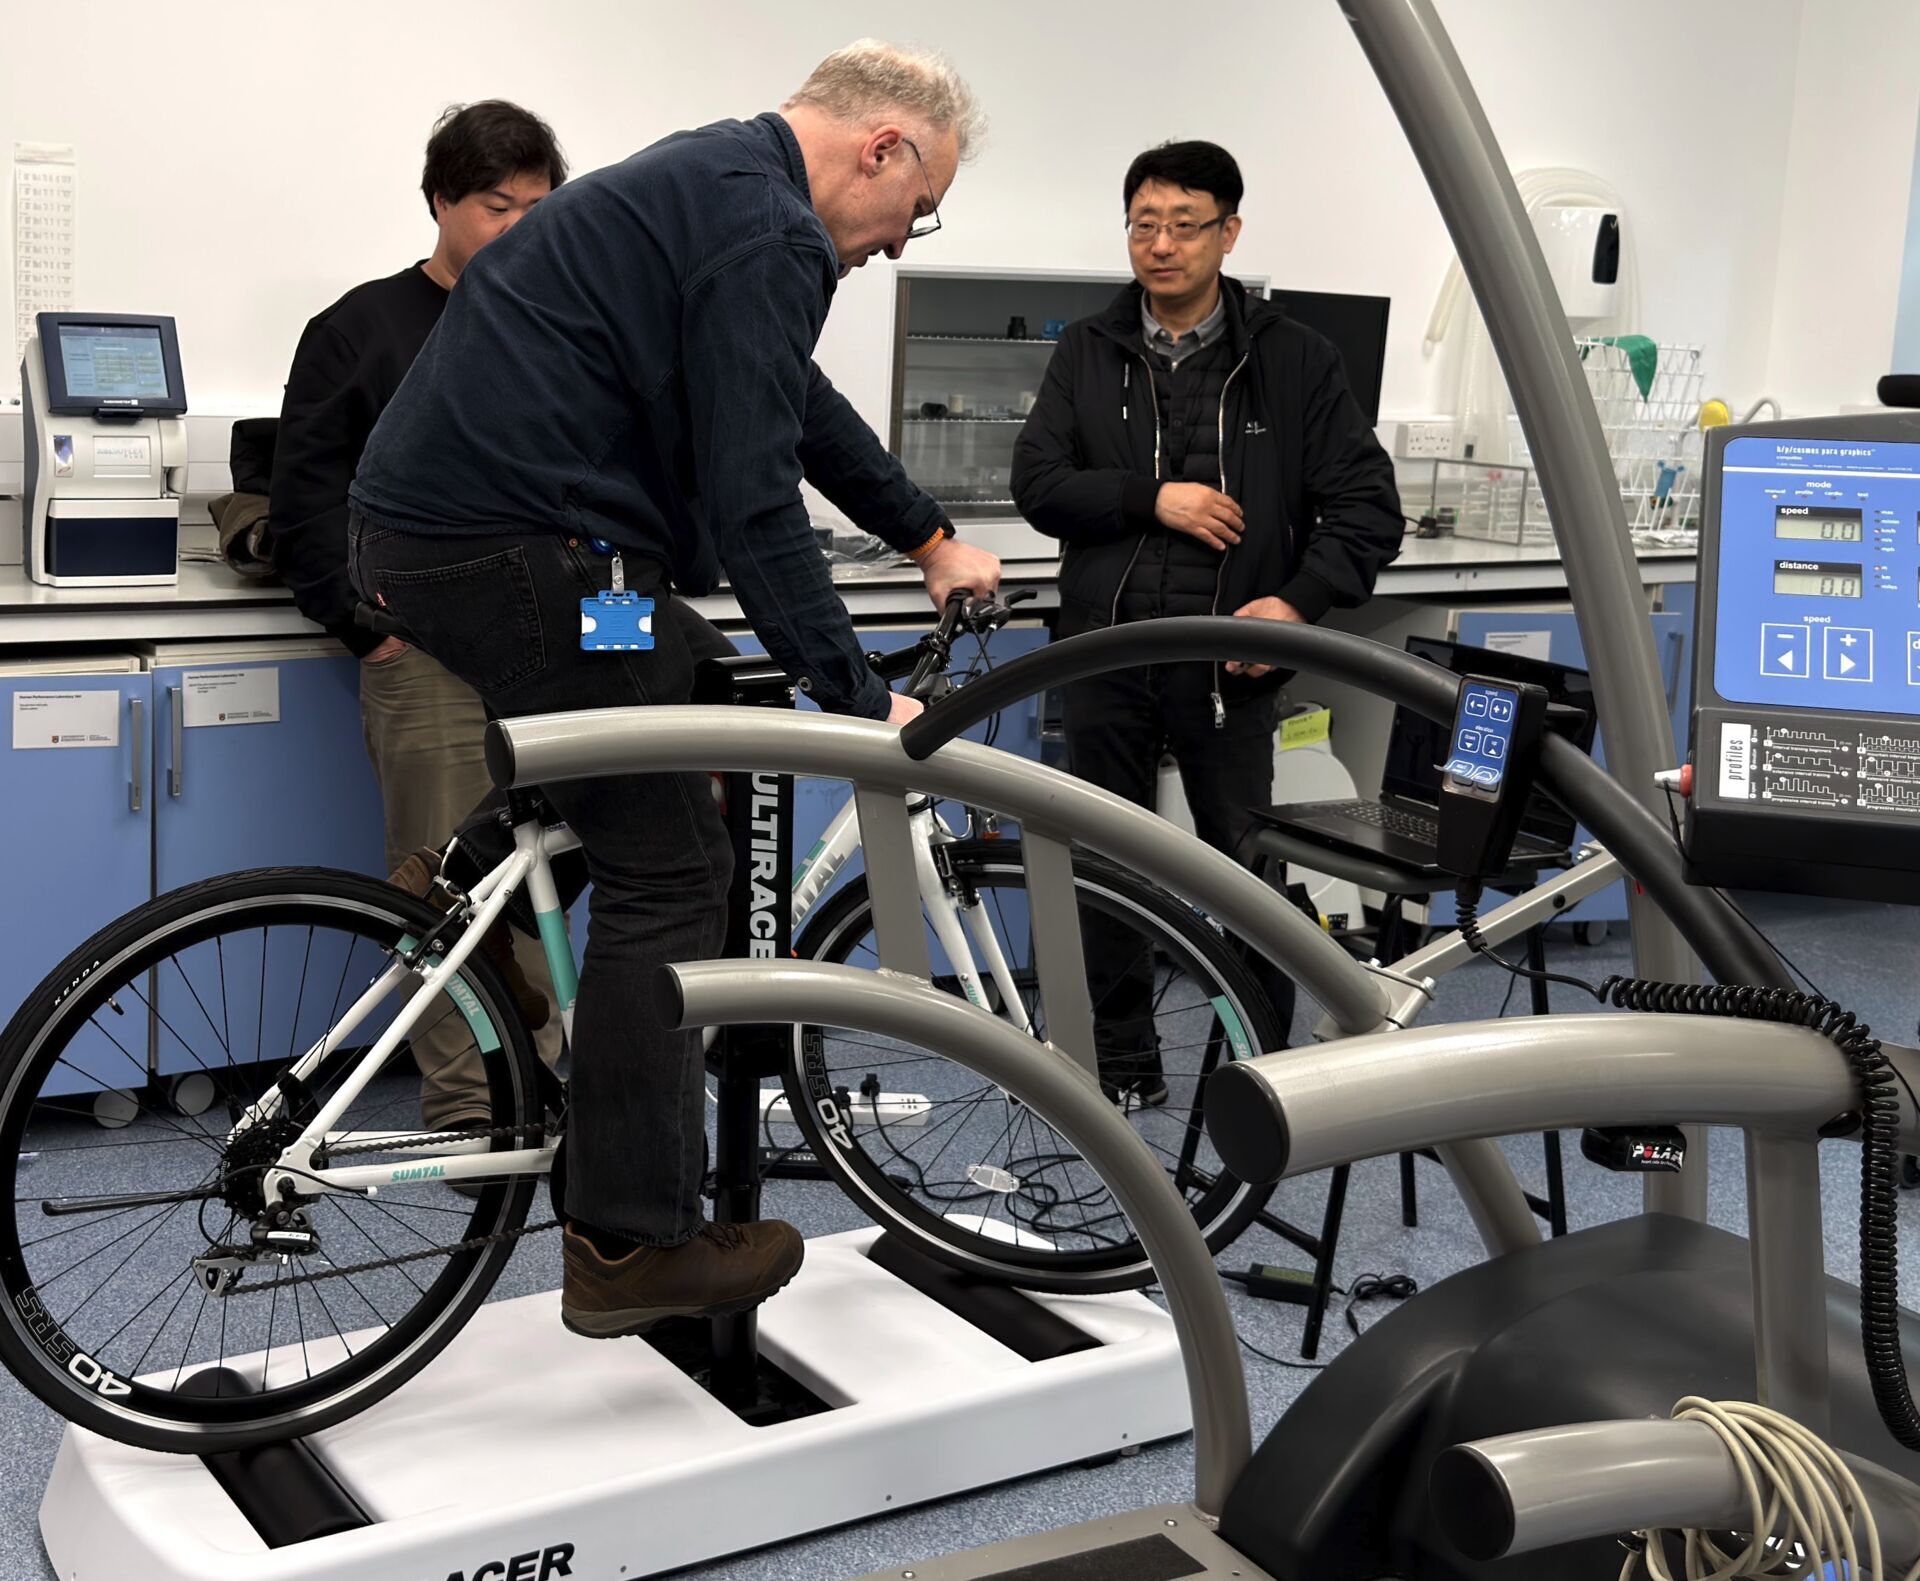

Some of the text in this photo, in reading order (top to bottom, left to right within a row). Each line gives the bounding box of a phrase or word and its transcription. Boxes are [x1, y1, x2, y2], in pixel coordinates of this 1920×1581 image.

[1839, 448, 1872, 457] graphics
[1780, 507, 1809, 515] speed
[1821, 521, 1855, 540] 0.0
[1779, 561, 1819, 570] distance
[1820, 577, 1855, 596] 0.0
[1803, 616, 1832, 624] speed
[1726, 739, 1746, 781] profiles
[750, 773, 779, 959] ULTIRACE
[54, 961, 100, 1006] KENDA
[817, 1097, 853, 1149] 40
[1632, 1144, 1682, 1164] POLAR
[391, 1164, 446, 1182] SUMTAL
[68, 1352, 132, 1395] 40
